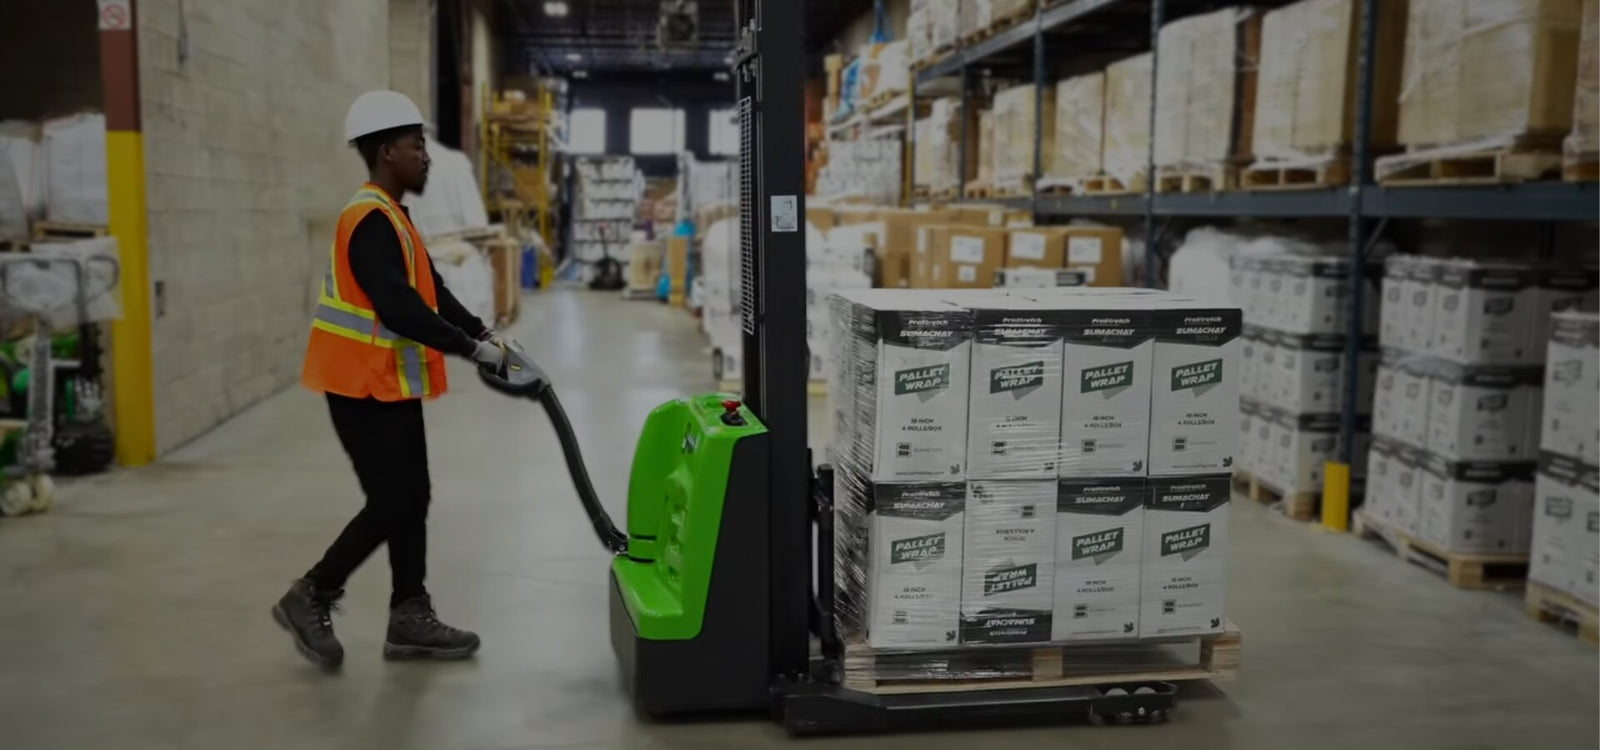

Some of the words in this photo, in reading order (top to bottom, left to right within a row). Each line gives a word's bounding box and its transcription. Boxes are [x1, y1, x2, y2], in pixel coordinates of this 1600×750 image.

[1083, 328, 1136, 336] SUMACHAY
[1175, 326, 1227, 334] SUMACHAY
[899, 366, 946, 382] PALLET
[1085, 365, 1129, 380] PALLET
[1175, 362, 1218, 378] PALLET
[904, 377, 942, 391] WRAP
[1000, 375, 1036, 388] WRAP
[1090, 375, 1126, 388] WRAP
[1181, 372, 1215, 386] WRAP
[1074, 496, 1126, 504] SUMACHAY
[1161, 493, 1211, 502] SUMACHAY
[1076, 531, 1119, 547] PALLET
[1165, 527, 1206, 543] PALLET
[895, 536, 941, 551] PALLET
[1081, 541, 1116, 555] WRAP
[1170, 537, 1203, 551] WRAP
[901, 546, 938, 560] WRAP
[992, 568, 1027, 582] WRAP
[990, 577, 1033, 592] PALLET
[985, 617, 1036, 627] SUMACHAY
